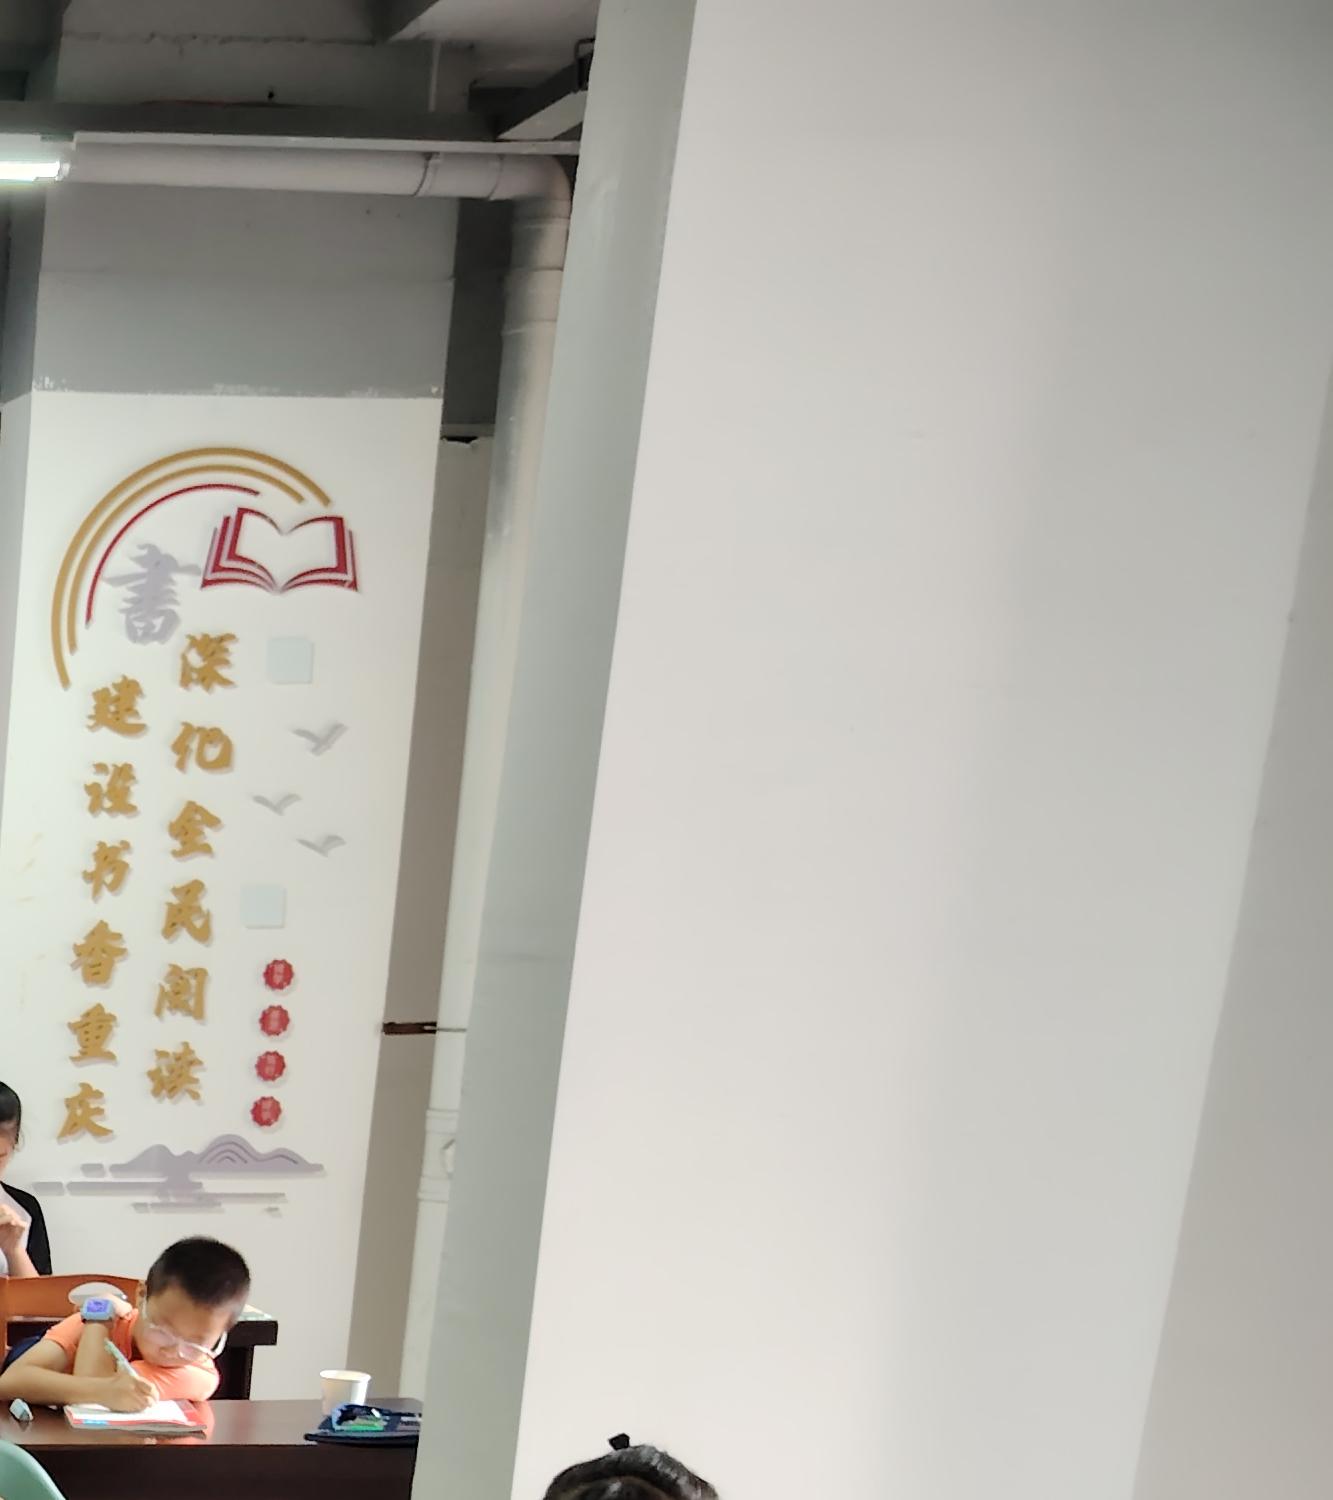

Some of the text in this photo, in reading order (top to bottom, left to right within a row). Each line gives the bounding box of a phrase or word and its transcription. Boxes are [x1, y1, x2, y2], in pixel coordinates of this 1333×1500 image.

[59, 675, 146, 1138] 建设书香重庆
[148, 633, 236, 1099] 深化全民阅读
